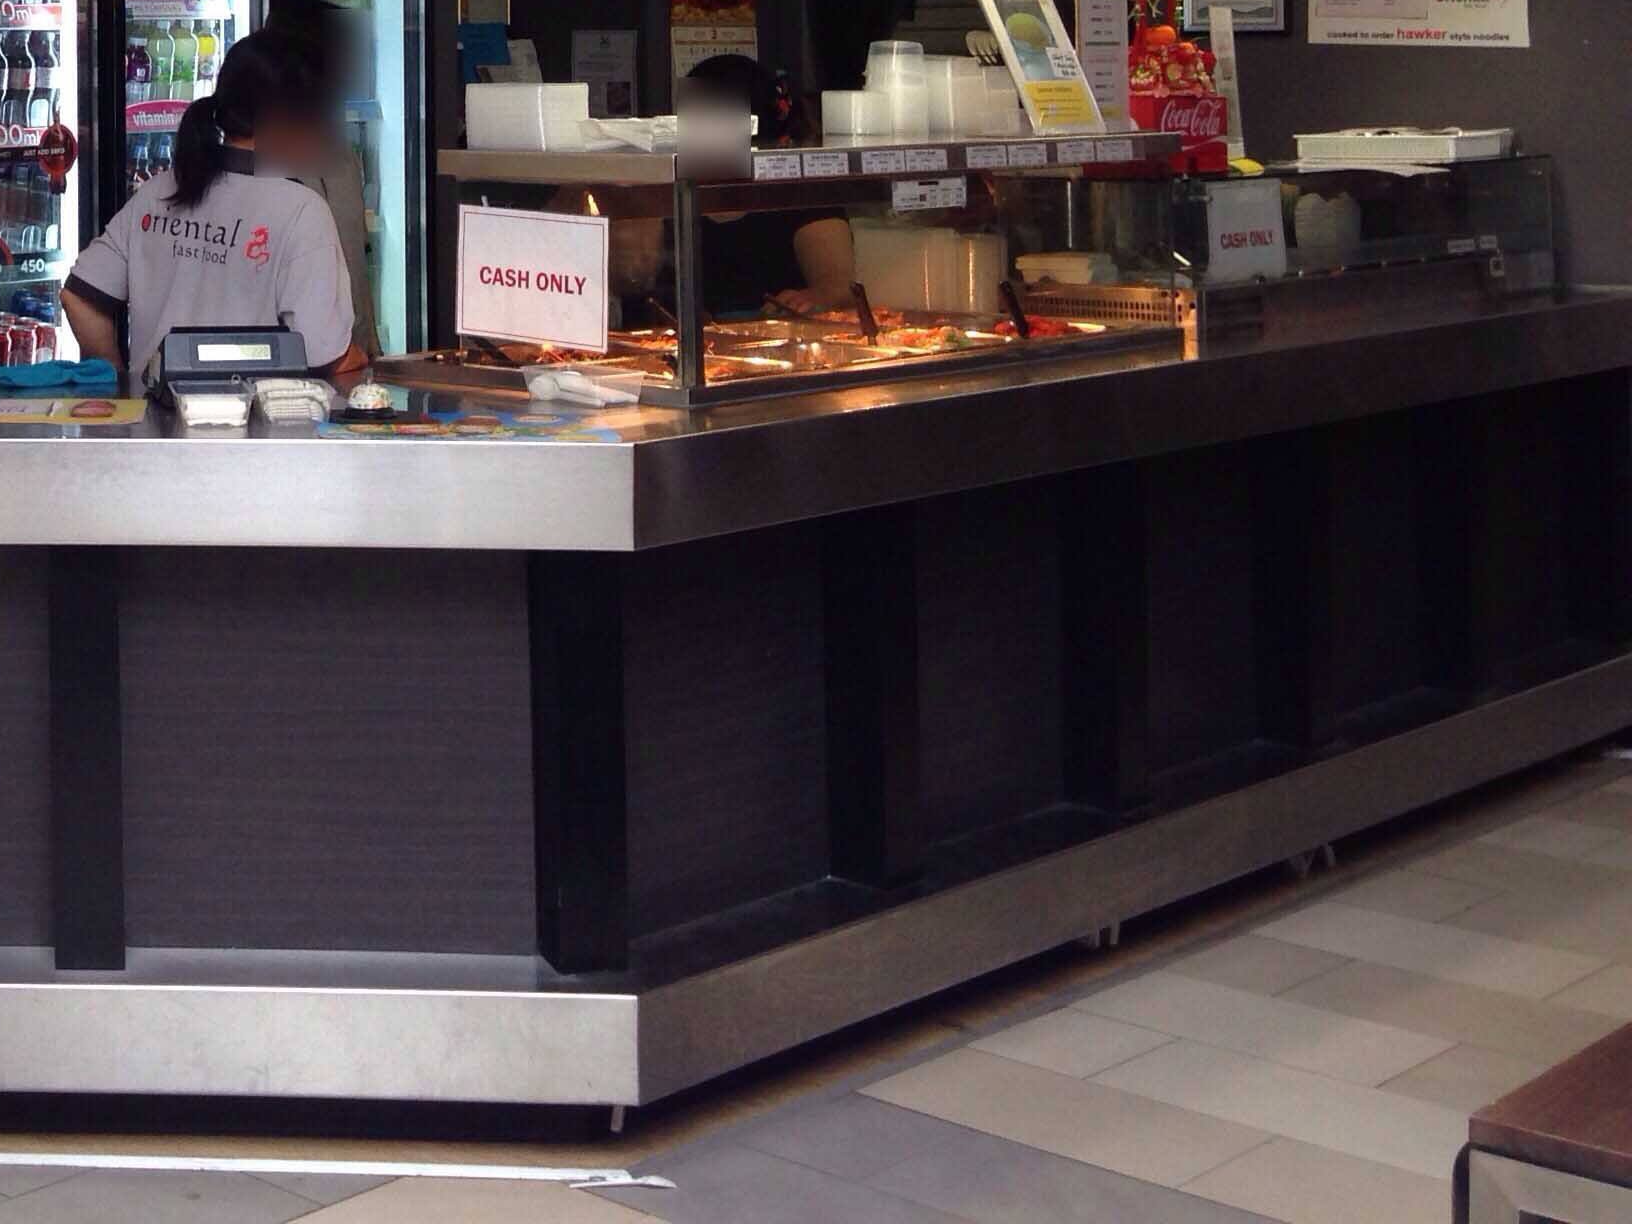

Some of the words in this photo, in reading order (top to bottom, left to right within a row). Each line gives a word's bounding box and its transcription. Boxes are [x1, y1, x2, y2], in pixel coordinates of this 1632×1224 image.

[1326, 31, 1359, 40] cooked
[1371, 31, 1395, 40] order
[1396, 27, 1449, 41] hawker
[132, 109, 182, 127] vitamin
[141, 206, 243, 248] oriental
[1219, 231, 1248, 250] CASH
[1249, 229, 1274, 247] ONLY
[172, 240, 199, 259] fast
[201, 246, 228, 265] food
[479, 265, 530, 289] CASH
[536, 272, 587, 296] ONLY
